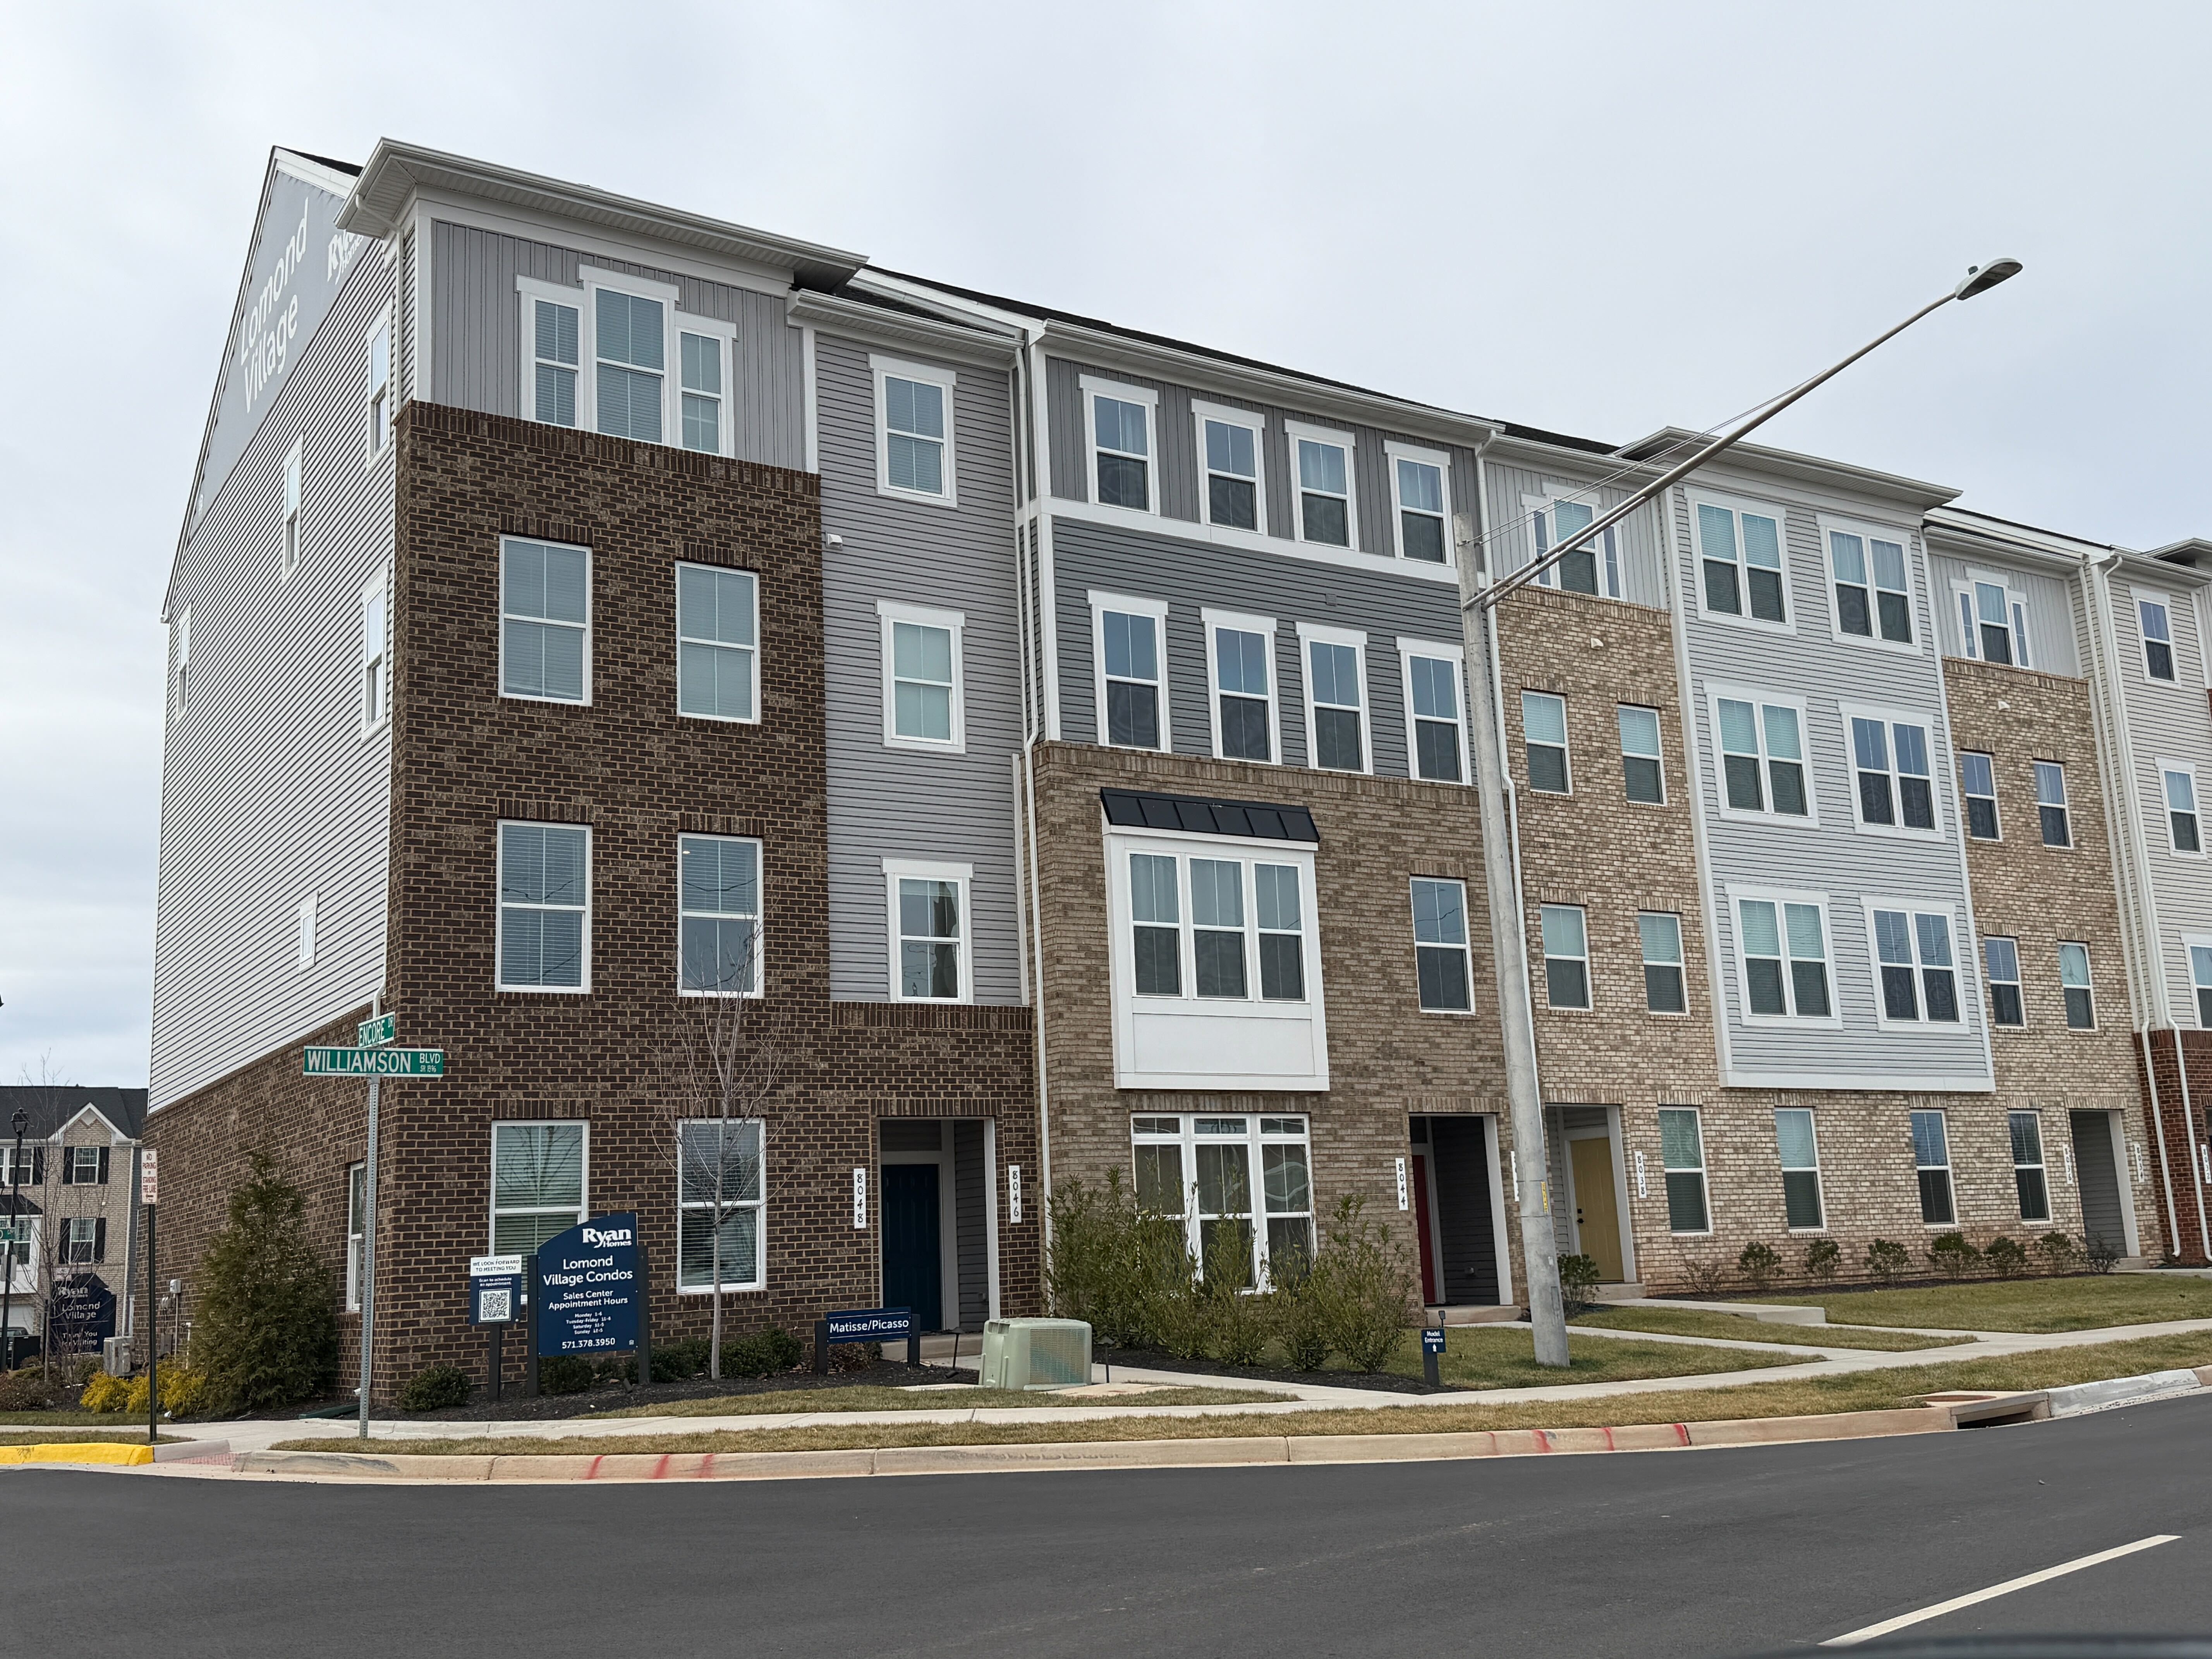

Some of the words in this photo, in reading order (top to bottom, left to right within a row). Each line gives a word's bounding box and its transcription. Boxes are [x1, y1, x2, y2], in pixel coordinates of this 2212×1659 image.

[327, 229, 356, 285] Ry
[241, 197, 308, 366] Lomond
[244, 294, 298, 413] Village
[359, 1020, 385, 1045] ENCORE
[388, 1017, 393, 1027] DR
[307, 1050, 411, 1073] WILLIAMSON
[419, 1053, 440, 1064] BLVD
[582, 1228, 632, 1248] Ryan
[563, 1255, 613, 1269] Lomond
[543, 1273, 584, 1286] Village
[586, 1269, 633, 1282] Condos
[58, 1287, 88, 1298] Ryan
[586, 1290, 614, 1298] Center
[548, 1298, 602, 1310] Appointment
[65, 1311, 97, 1321] Village
[830, 1319, 909, 1333] Matisse/Picasso
[562, 1338, 615, 1348] 571.378.3950
